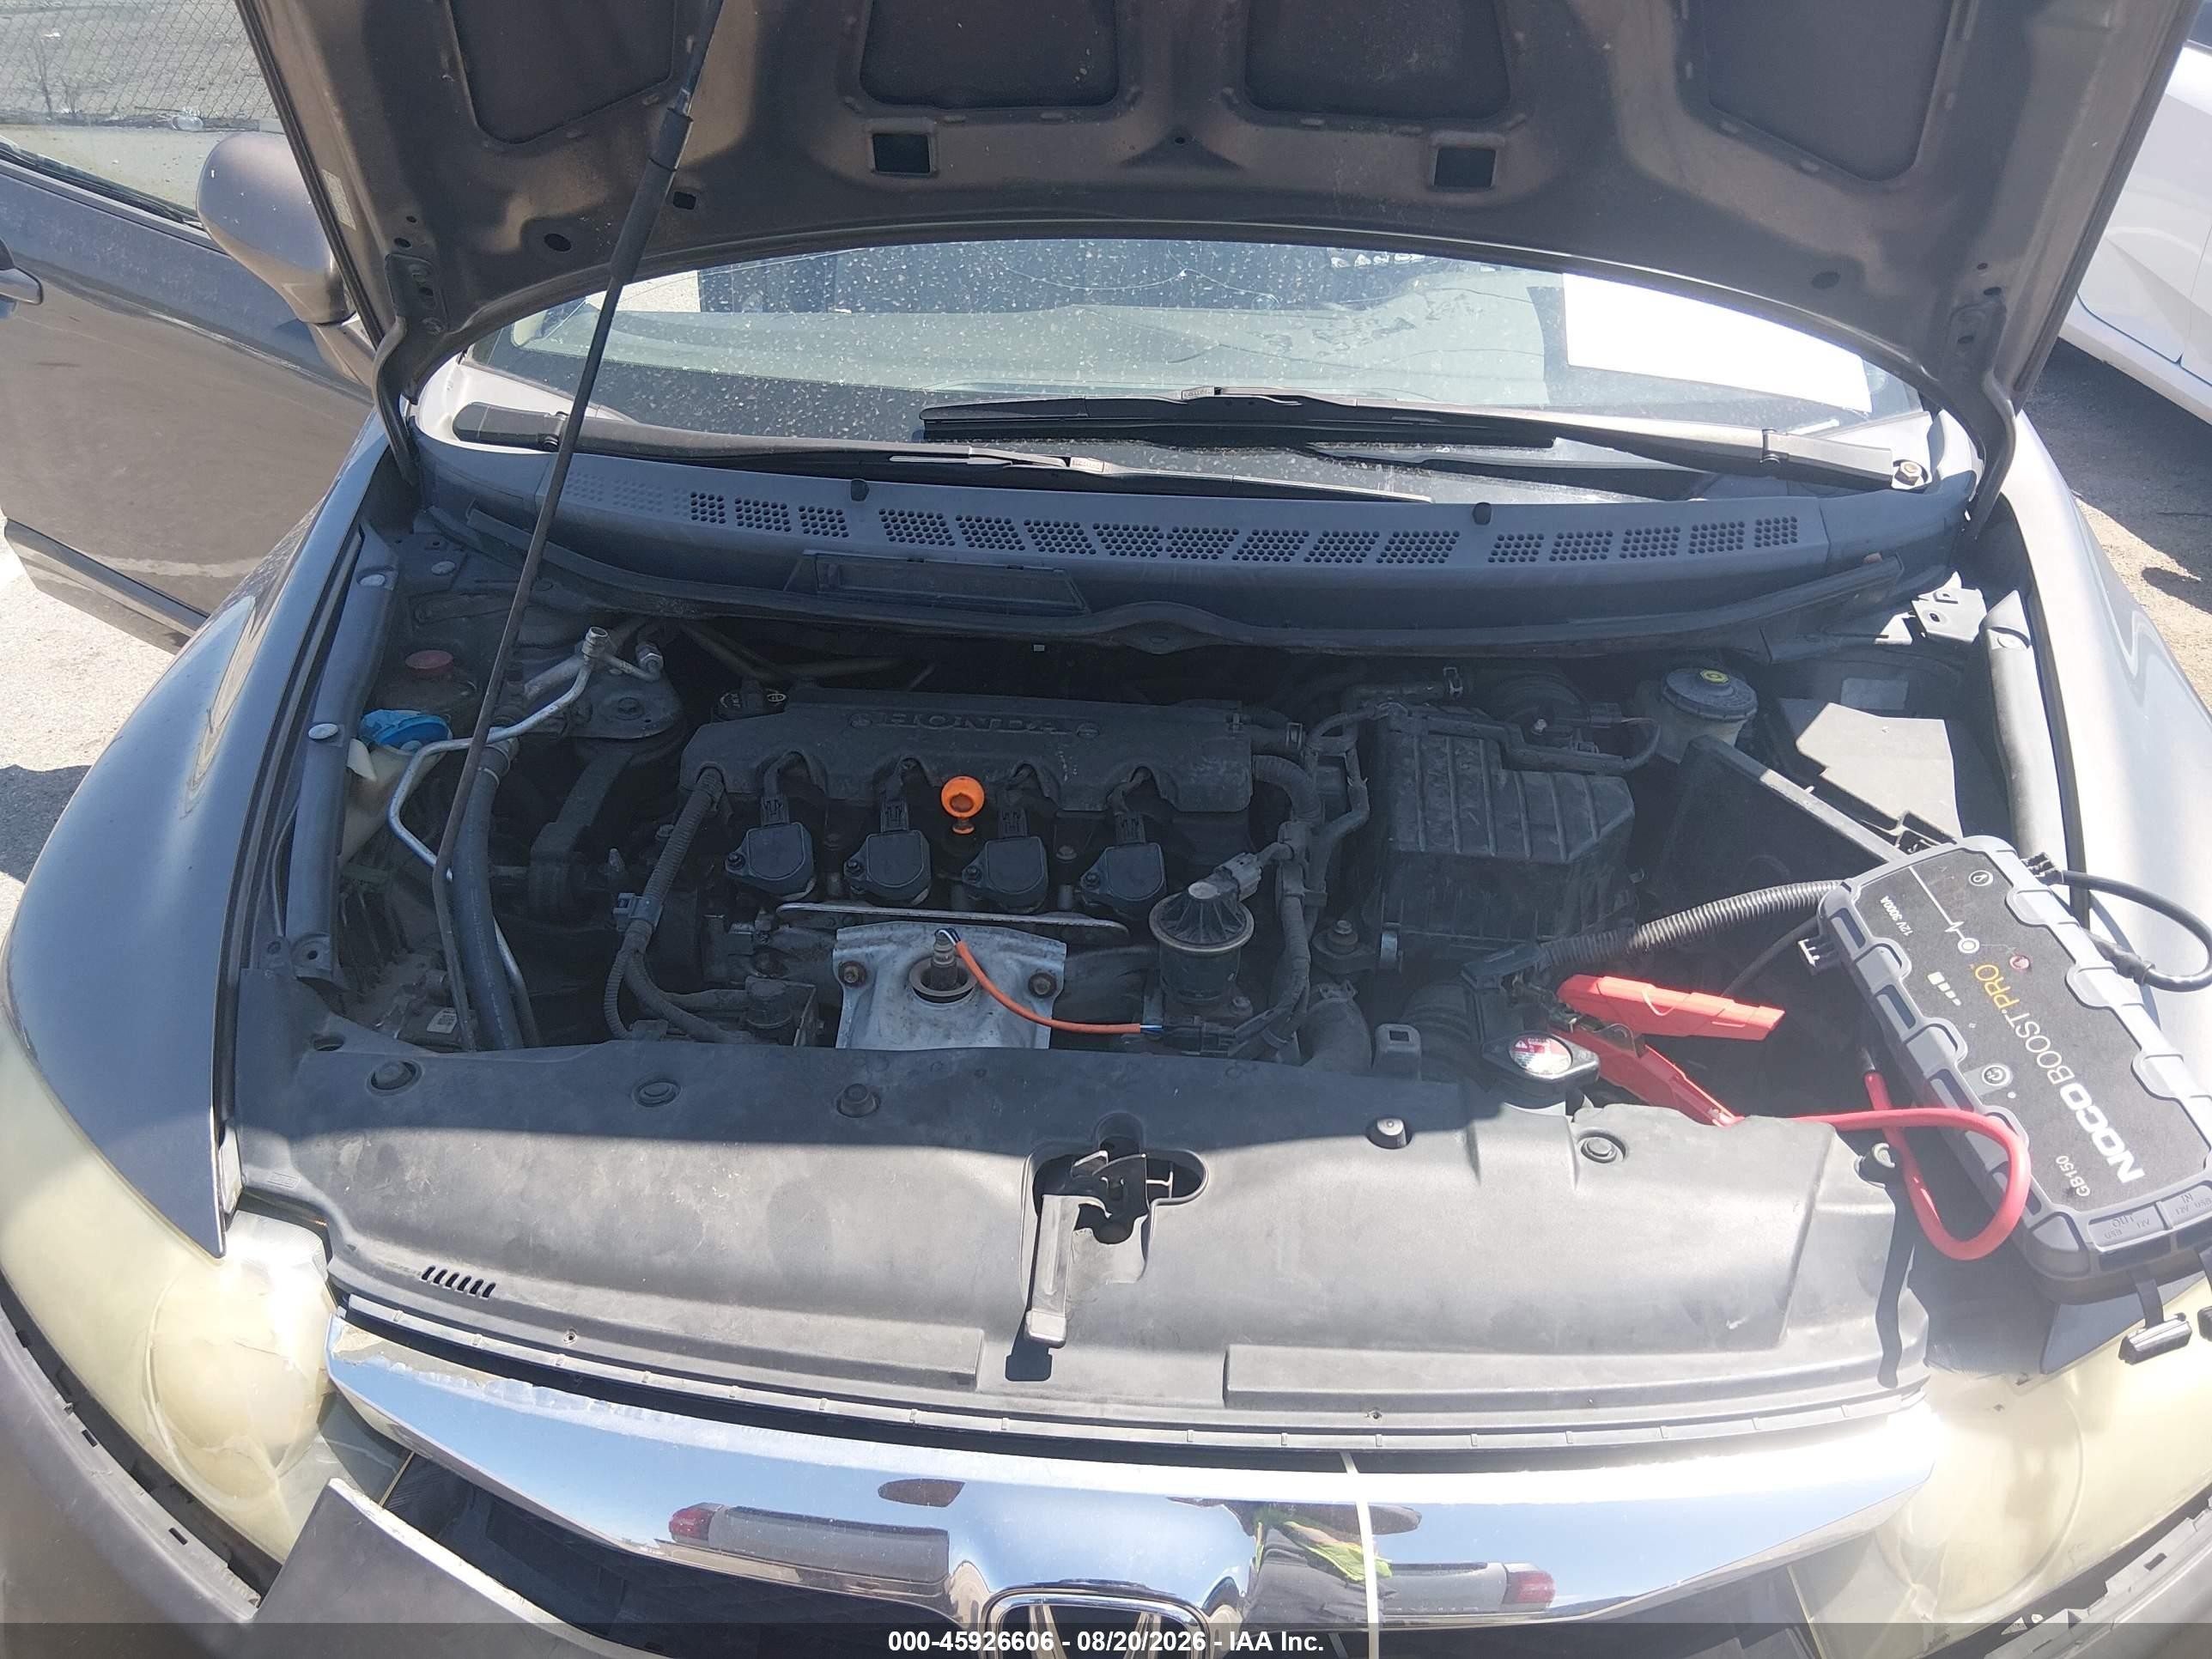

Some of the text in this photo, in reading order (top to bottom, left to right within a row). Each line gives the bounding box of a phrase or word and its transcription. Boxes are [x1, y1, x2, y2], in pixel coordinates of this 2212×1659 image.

[1880, 896, 1913, 936] 12V 3000A
[1974, 963, 2021, 1010] PRO
[2059, 1082, 2146, 1184] NOCO
[2055, 1155, 2091, 1197] GB150
[2175, 1197, 2212, 1215] 12V USB
[2181, 1192, 2194, 1204] IN
[2104, 1218, 2150, 1239] USB 12V
[2112, 1215, 2135, 1228] OUT
